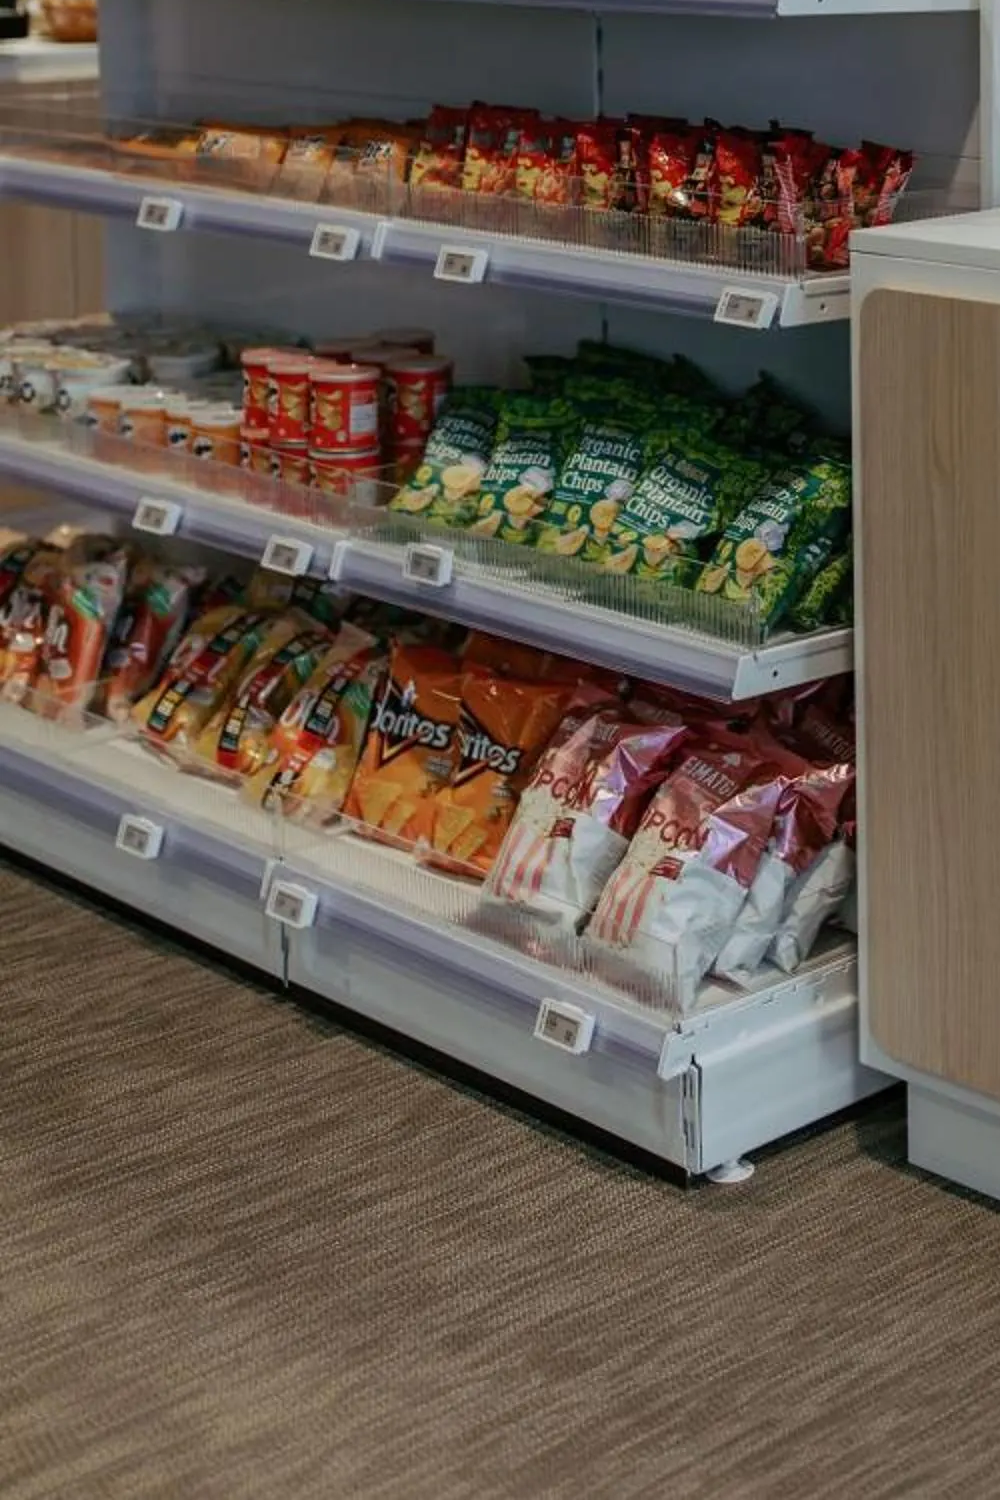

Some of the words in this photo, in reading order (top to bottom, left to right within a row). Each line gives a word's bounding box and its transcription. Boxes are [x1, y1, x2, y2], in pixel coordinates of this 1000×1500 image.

[561, 471, 605, 495] Chips
[568, 452, 638, 482] Plantain
[638, 480, 706, 526] Plantain
[650, 465, 713, 508] Organic
[626, 496, 671, 529] Chips
[462, 732, 521, 773] ritos
